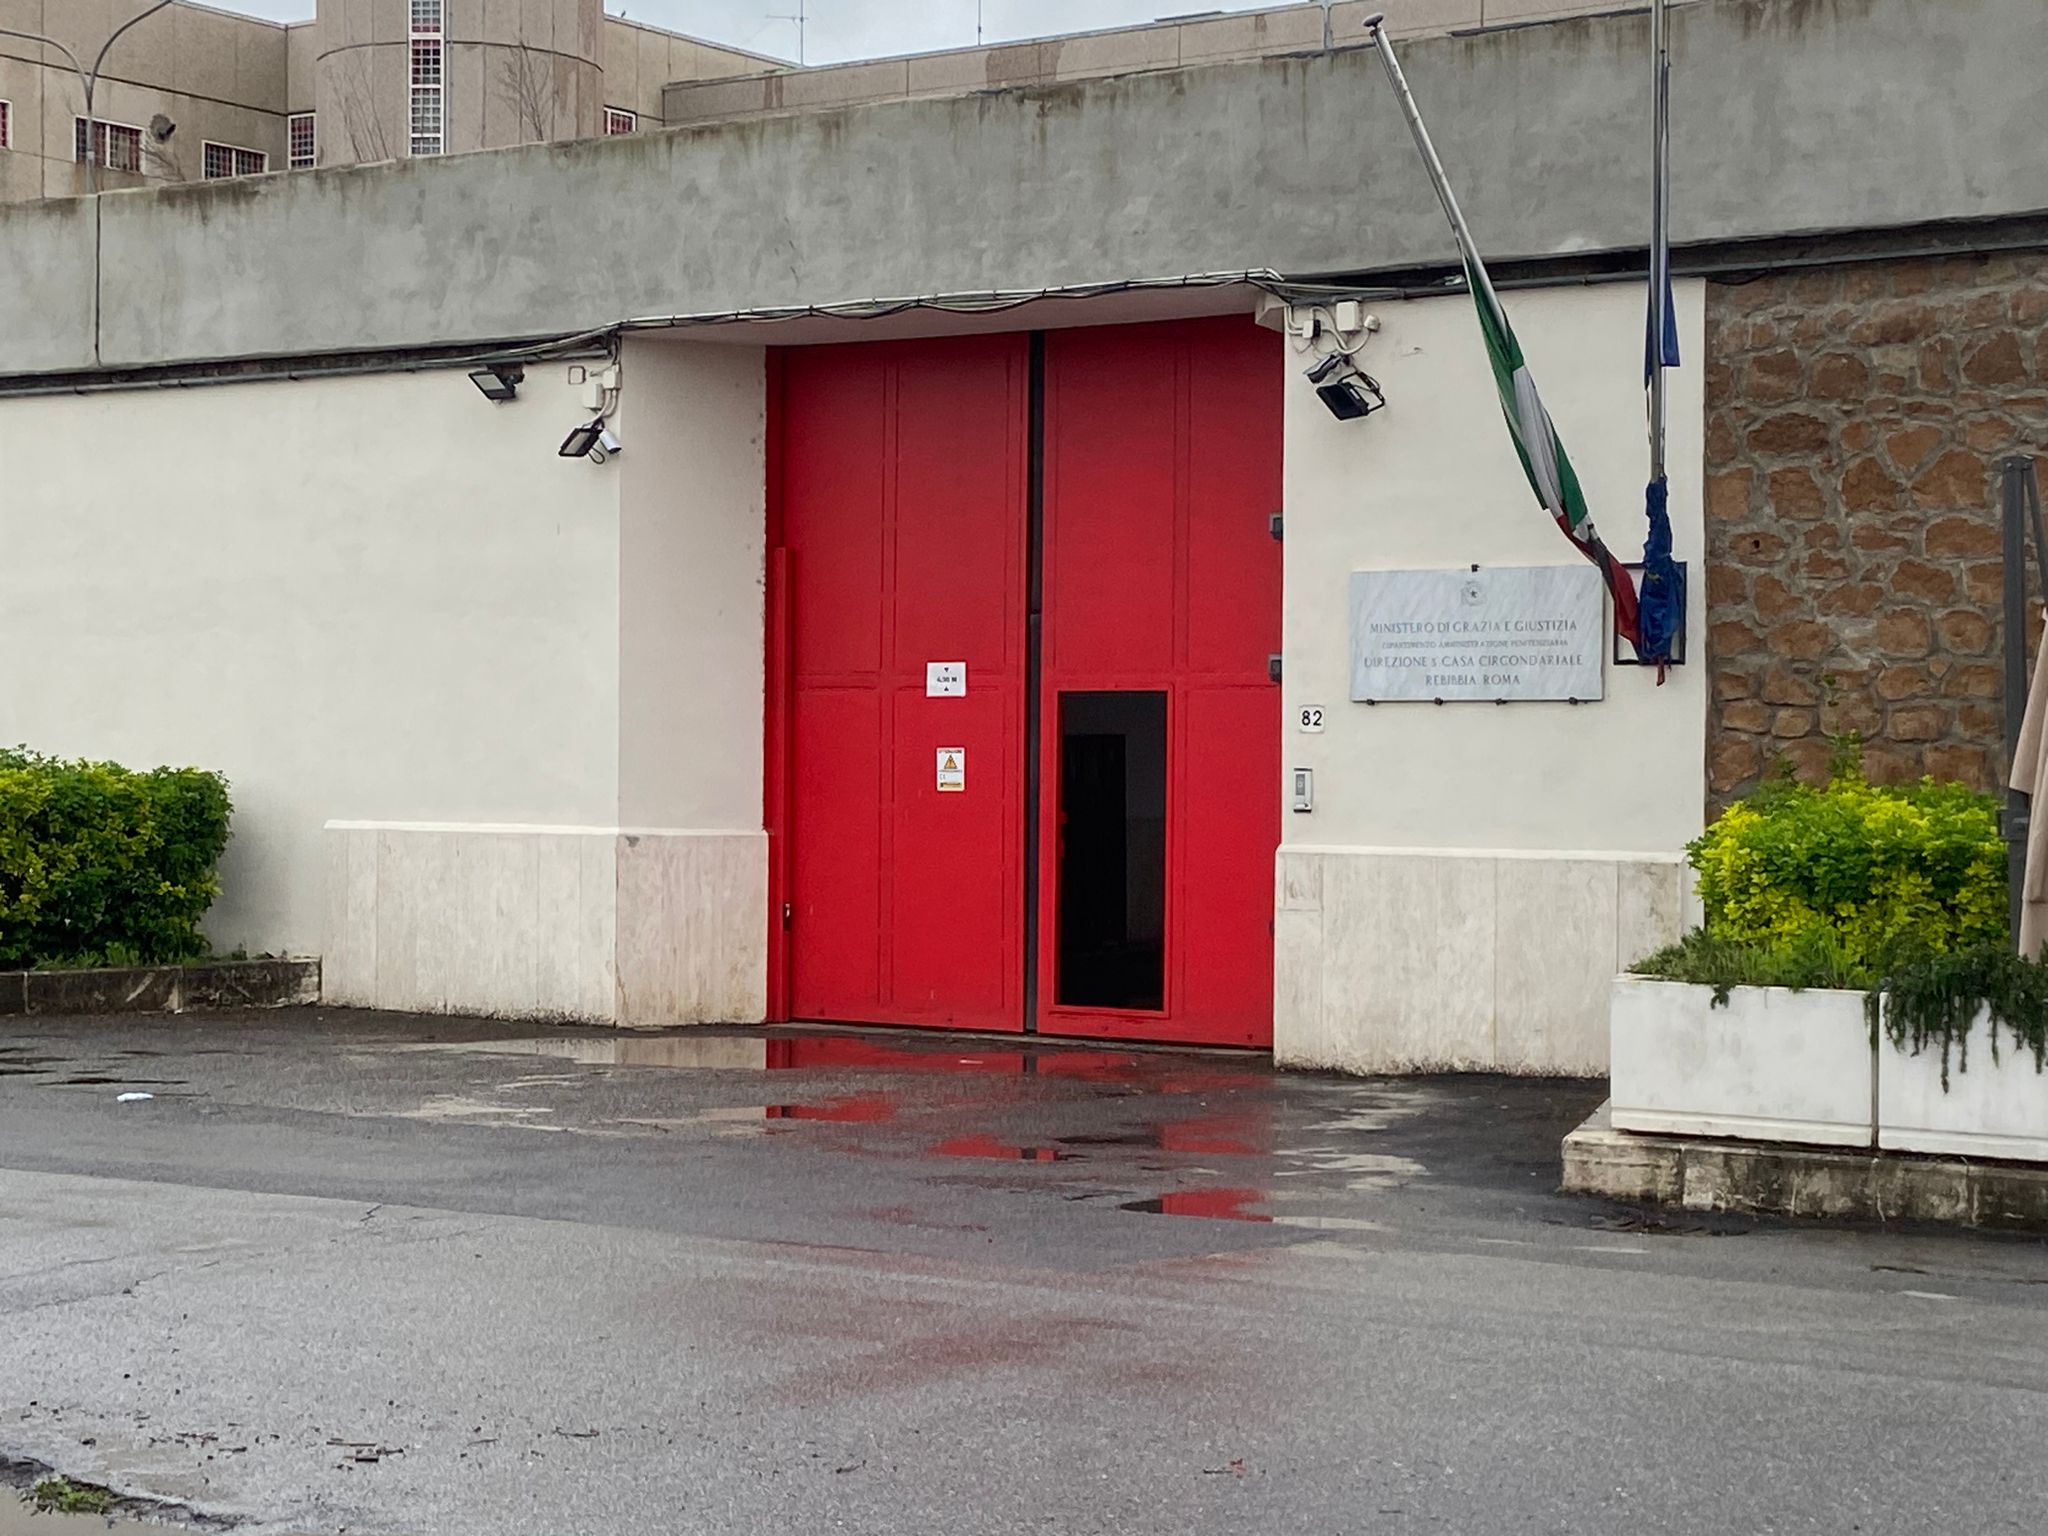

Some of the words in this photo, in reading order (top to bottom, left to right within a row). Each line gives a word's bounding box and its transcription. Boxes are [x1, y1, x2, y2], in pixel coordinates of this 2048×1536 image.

[1370, 621, 1434, 634] MINISTERO
[1437, 621, 1450, 633] DI
[1452, 620, 1501, 633] GRAZIA
[1504, 620, 1511, 632] E
[1514, 619, 1577, 632] GIUSTIZIA
[1364, 656, 1428, 668] DIREZIONE
[1441, 655, 1475, 667] CASA
[1478, 654, 1583, 666] CIRCONDARIALE
[1425, 674, 1477, 687] REBIBBIA
[1482, 673, 1521, 686] ROMA
[1301, 710, 1323, 726] 82
